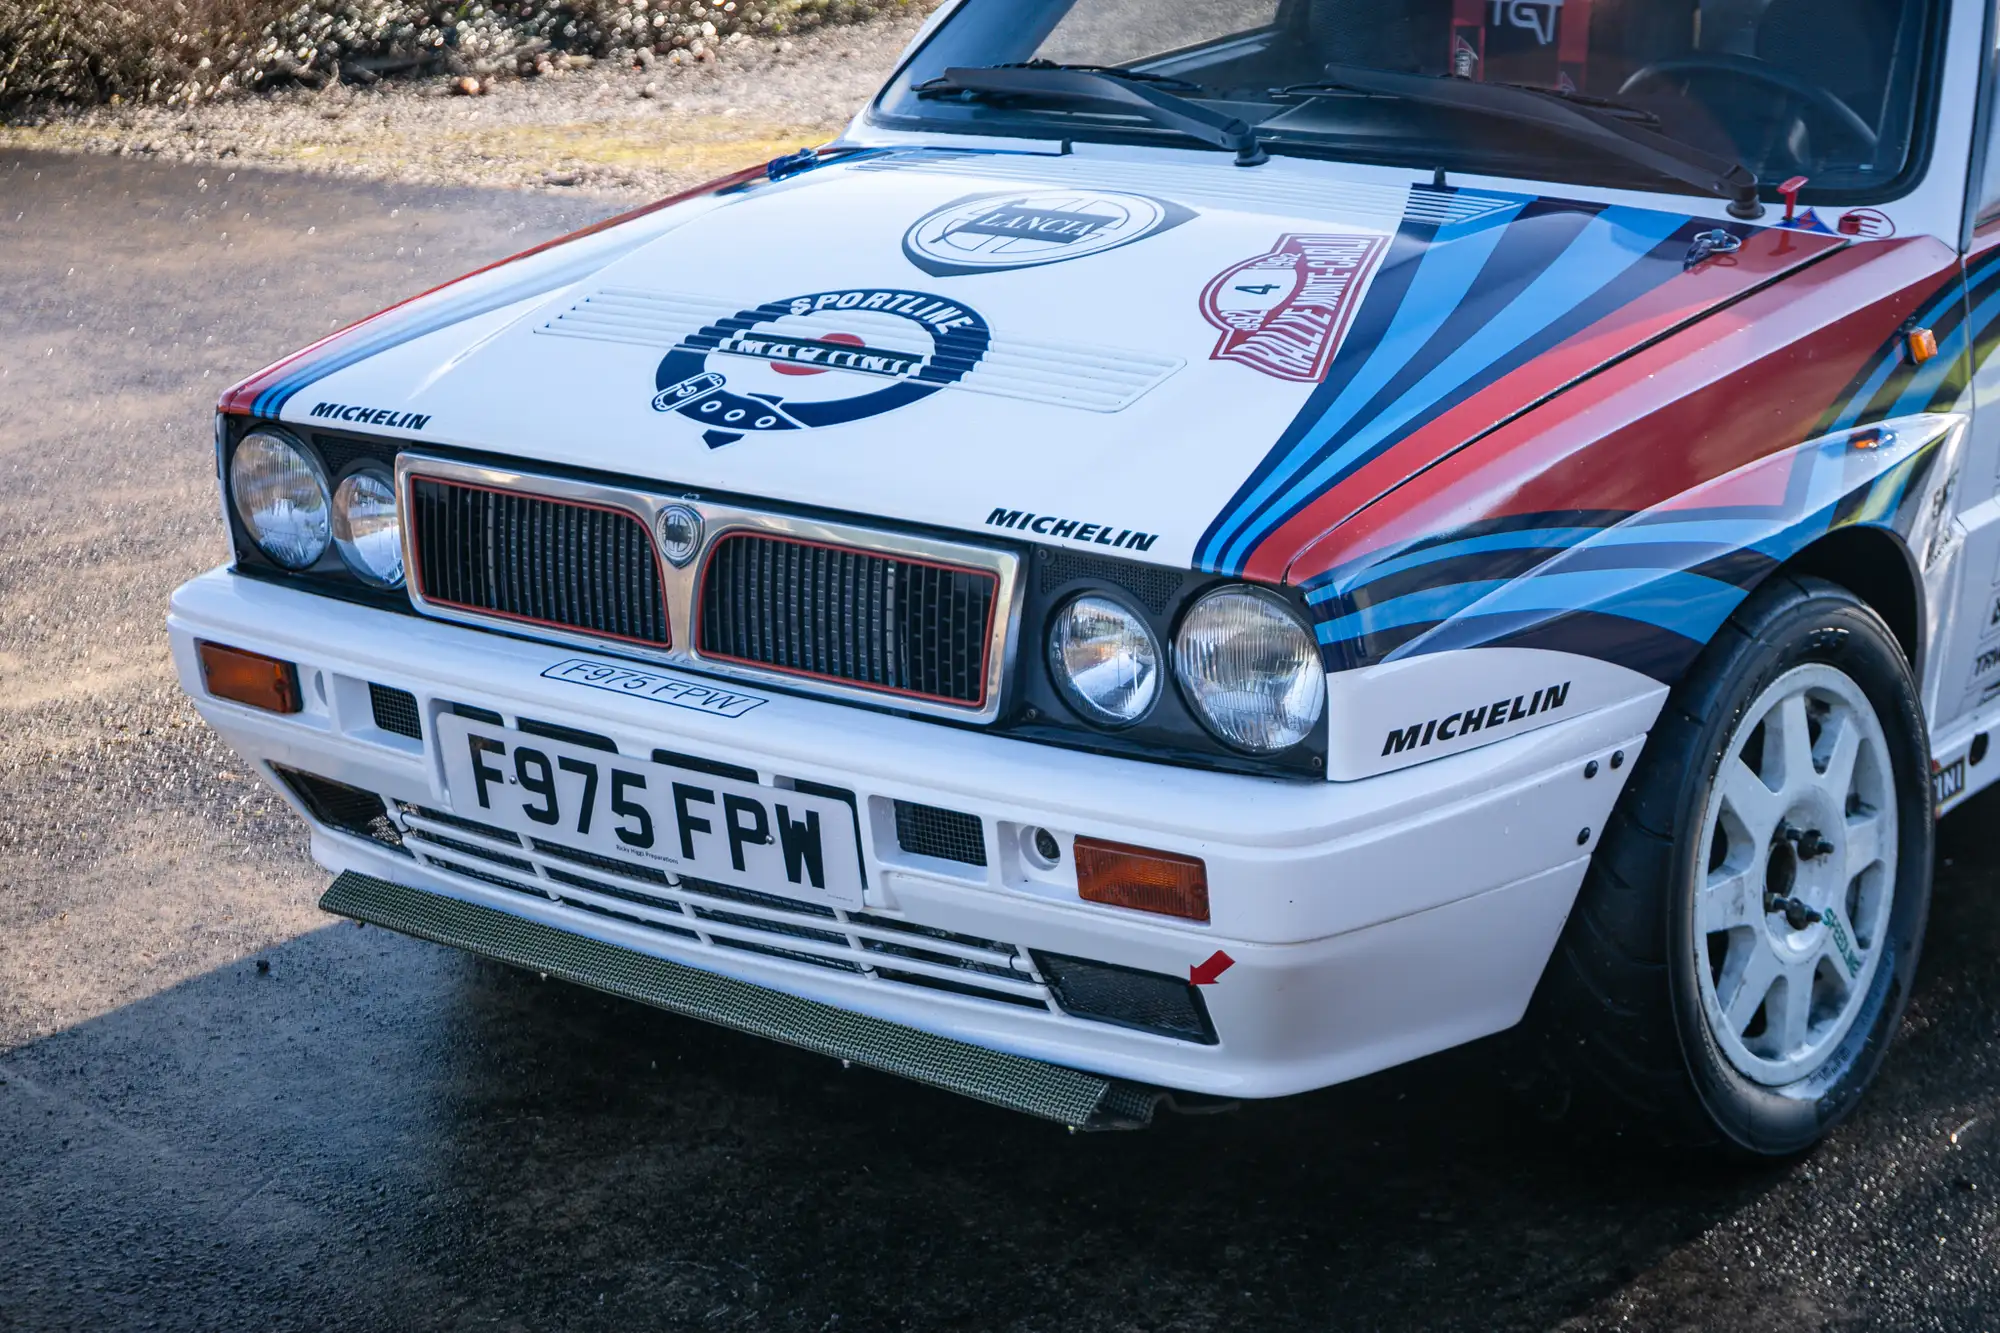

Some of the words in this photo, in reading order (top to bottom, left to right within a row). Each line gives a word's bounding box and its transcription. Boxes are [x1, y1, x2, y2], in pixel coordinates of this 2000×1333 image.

[977, 213, 1097, 237] LANCIA
[1230, 308, 1332, 374] RALLYE
[1290, 238, 1372, 311] MONTE-CARLO
[1235, 284, 1281, 295] 4
[790, 292, 974, 335] SPORTLINE
[736, 339, 908, 373] MARTINI
[310, 402, 432, 430] MICHELIN
[985, 507, 1159, 552] MICHELIN
[562, 663, 653, 690] F975
[651, 682, 749, 710] FPW
[1381, 680, 1571, 757] MICHELIN
[467, 733, 655, 849] F975
[672, 781, 826, 890] FPW
[645, 851, 679, 864] Preparations
